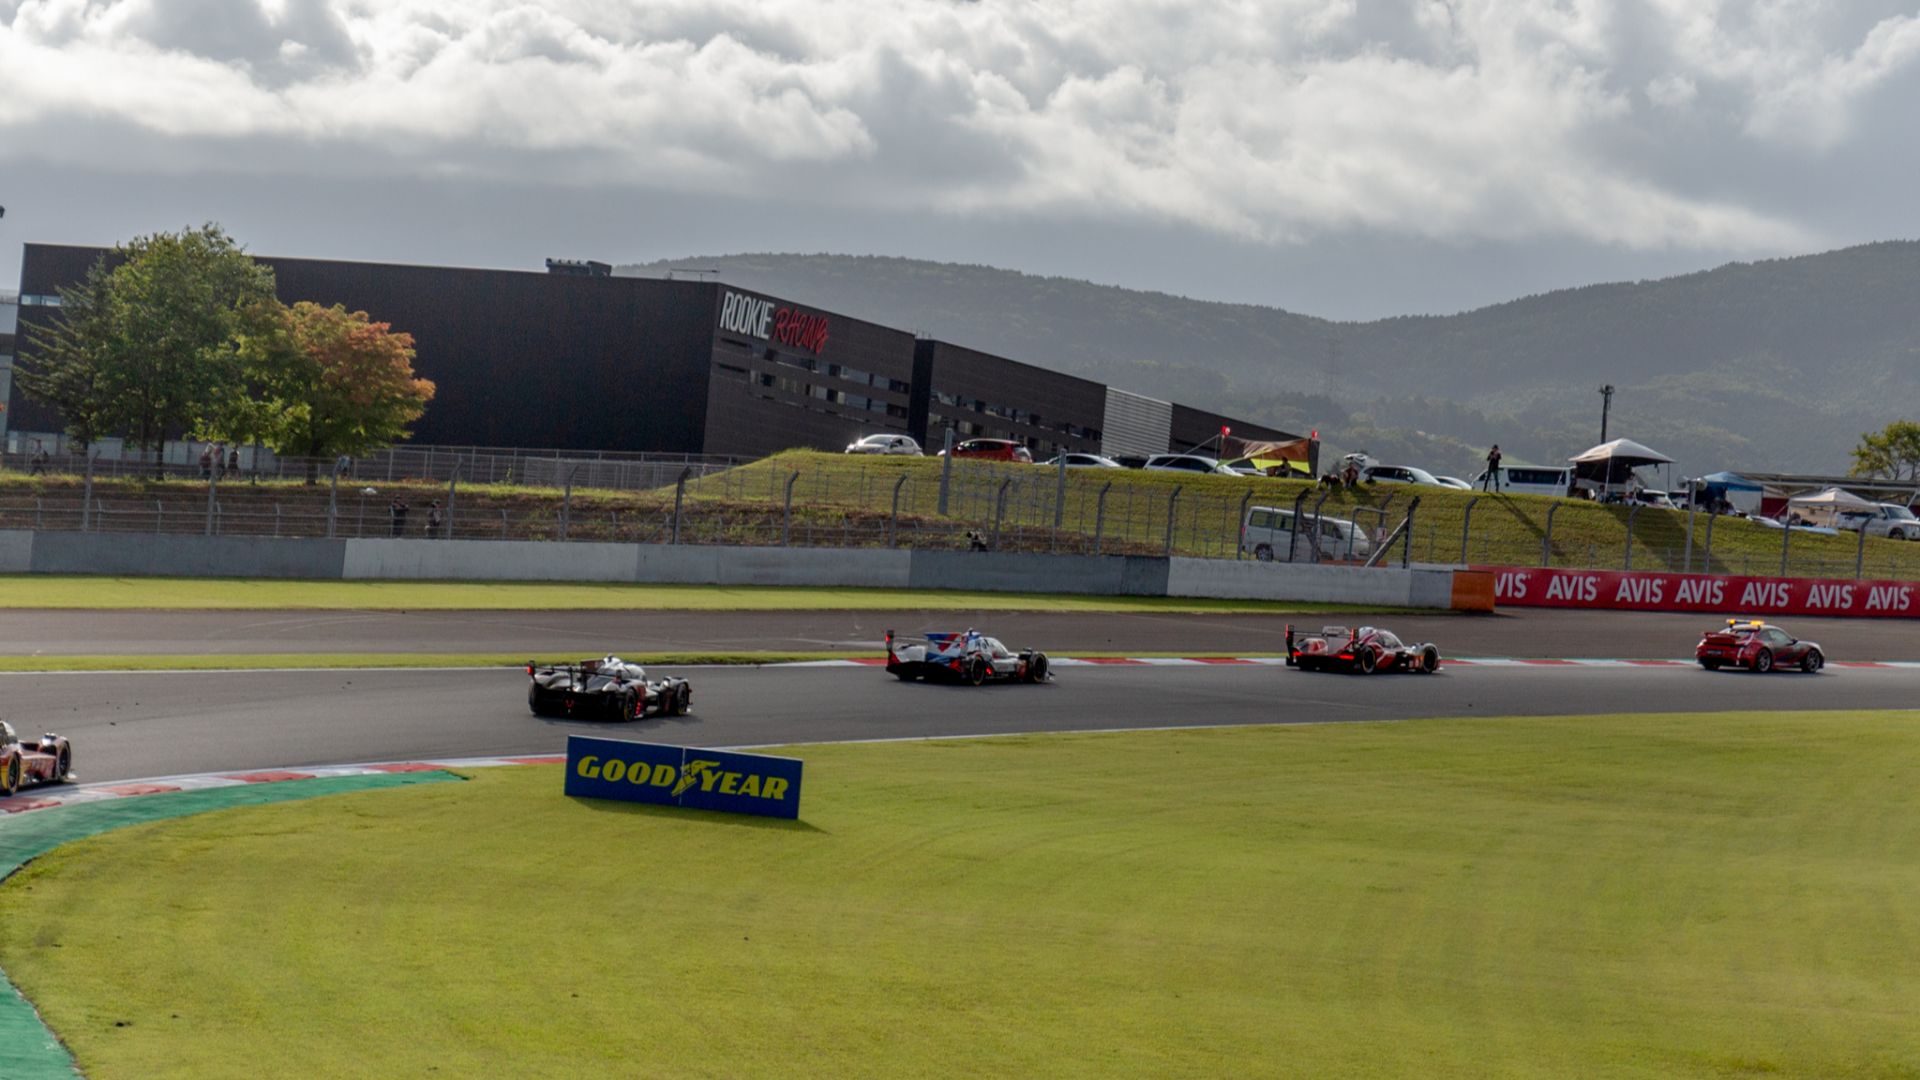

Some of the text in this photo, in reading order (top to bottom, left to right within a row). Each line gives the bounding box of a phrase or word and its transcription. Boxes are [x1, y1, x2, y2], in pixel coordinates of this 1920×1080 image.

[720, 291, 775, 340] ROOKIE
[1494, 573, 1910, 610] VIS AVIS AVIS AVIS AVIS AVIS AVIS
